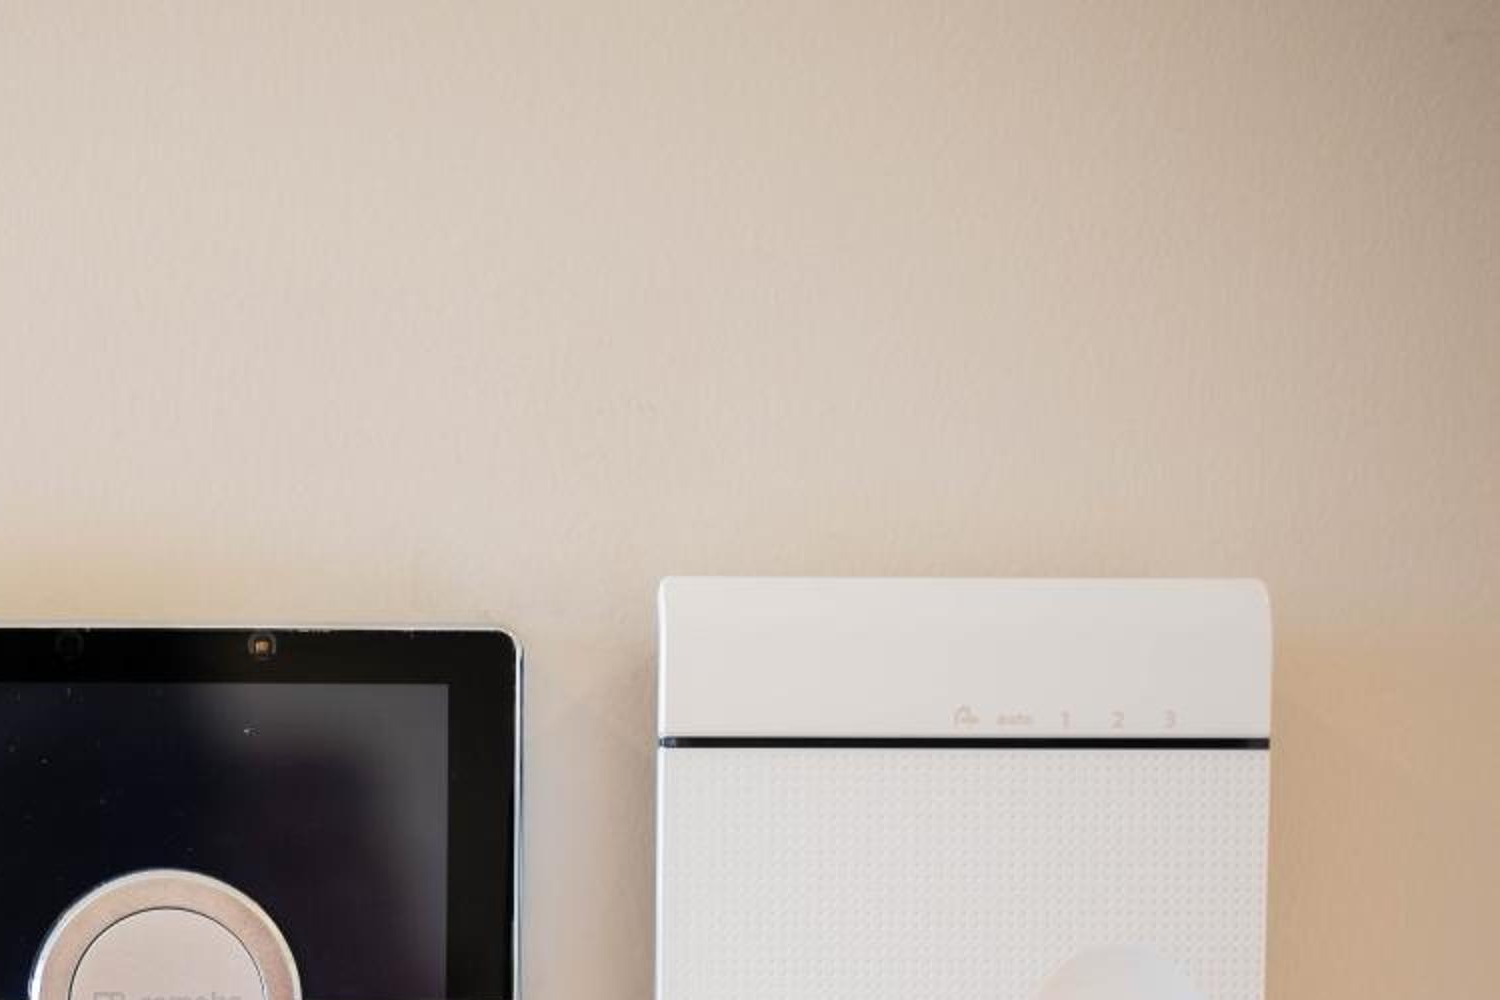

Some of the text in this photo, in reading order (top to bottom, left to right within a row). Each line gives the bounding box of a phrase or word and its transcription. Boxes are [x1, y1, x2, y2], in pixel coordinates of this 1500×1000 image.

[1060, 709, 1071, 729] 1
[1109, 710, 1125, 729] 2
[1163, 709, 1177, 729] 3
